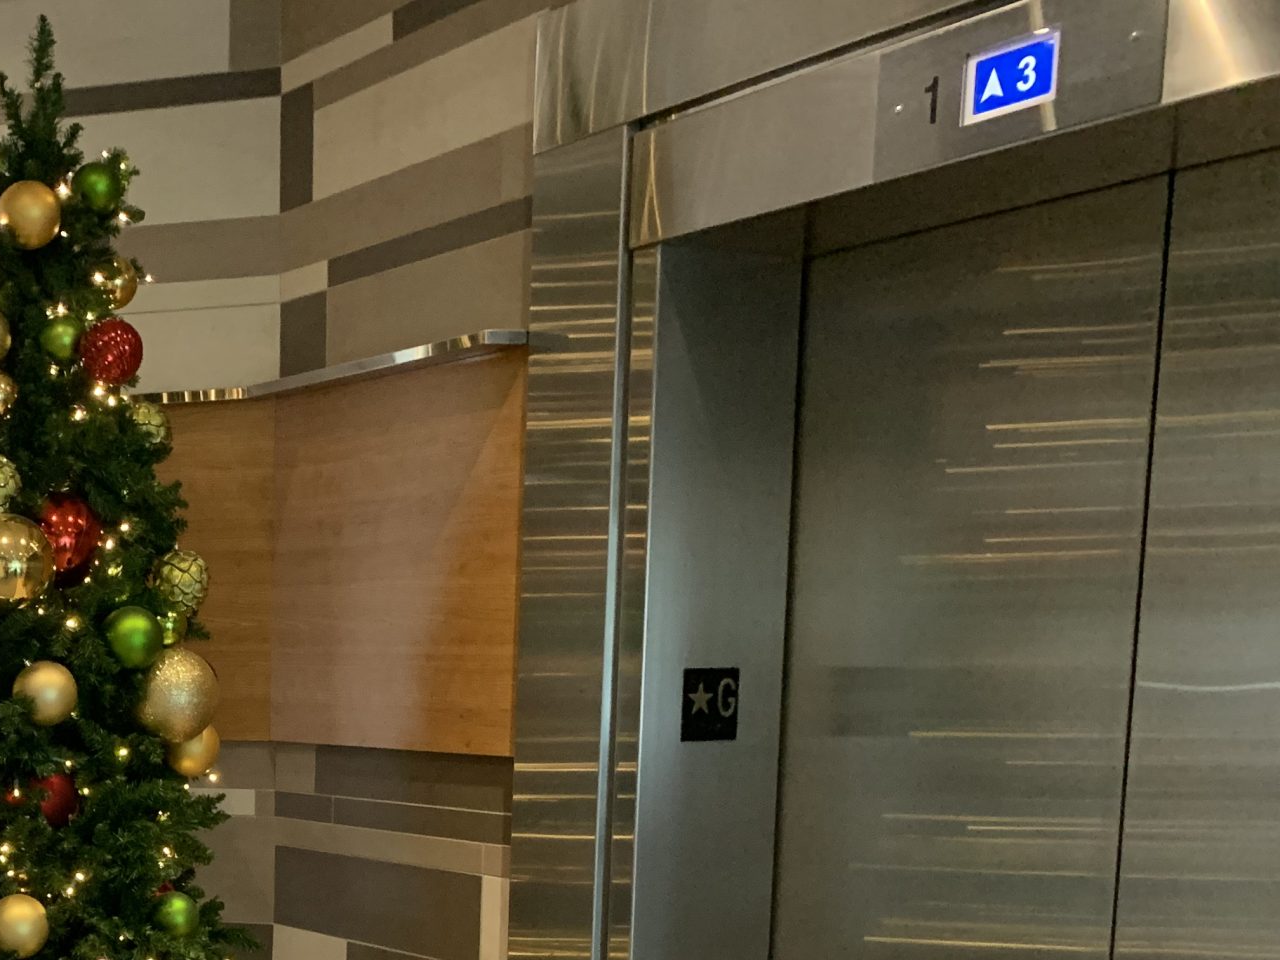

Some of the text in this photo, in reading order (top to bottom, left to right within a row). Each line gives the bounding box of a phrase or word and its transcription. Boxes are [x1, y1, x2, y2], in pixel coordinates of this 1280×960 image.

[1016, 55, 1037, 91] 3
[924, 75, 939, 124] 1
[718, 678, 736, 717] G
